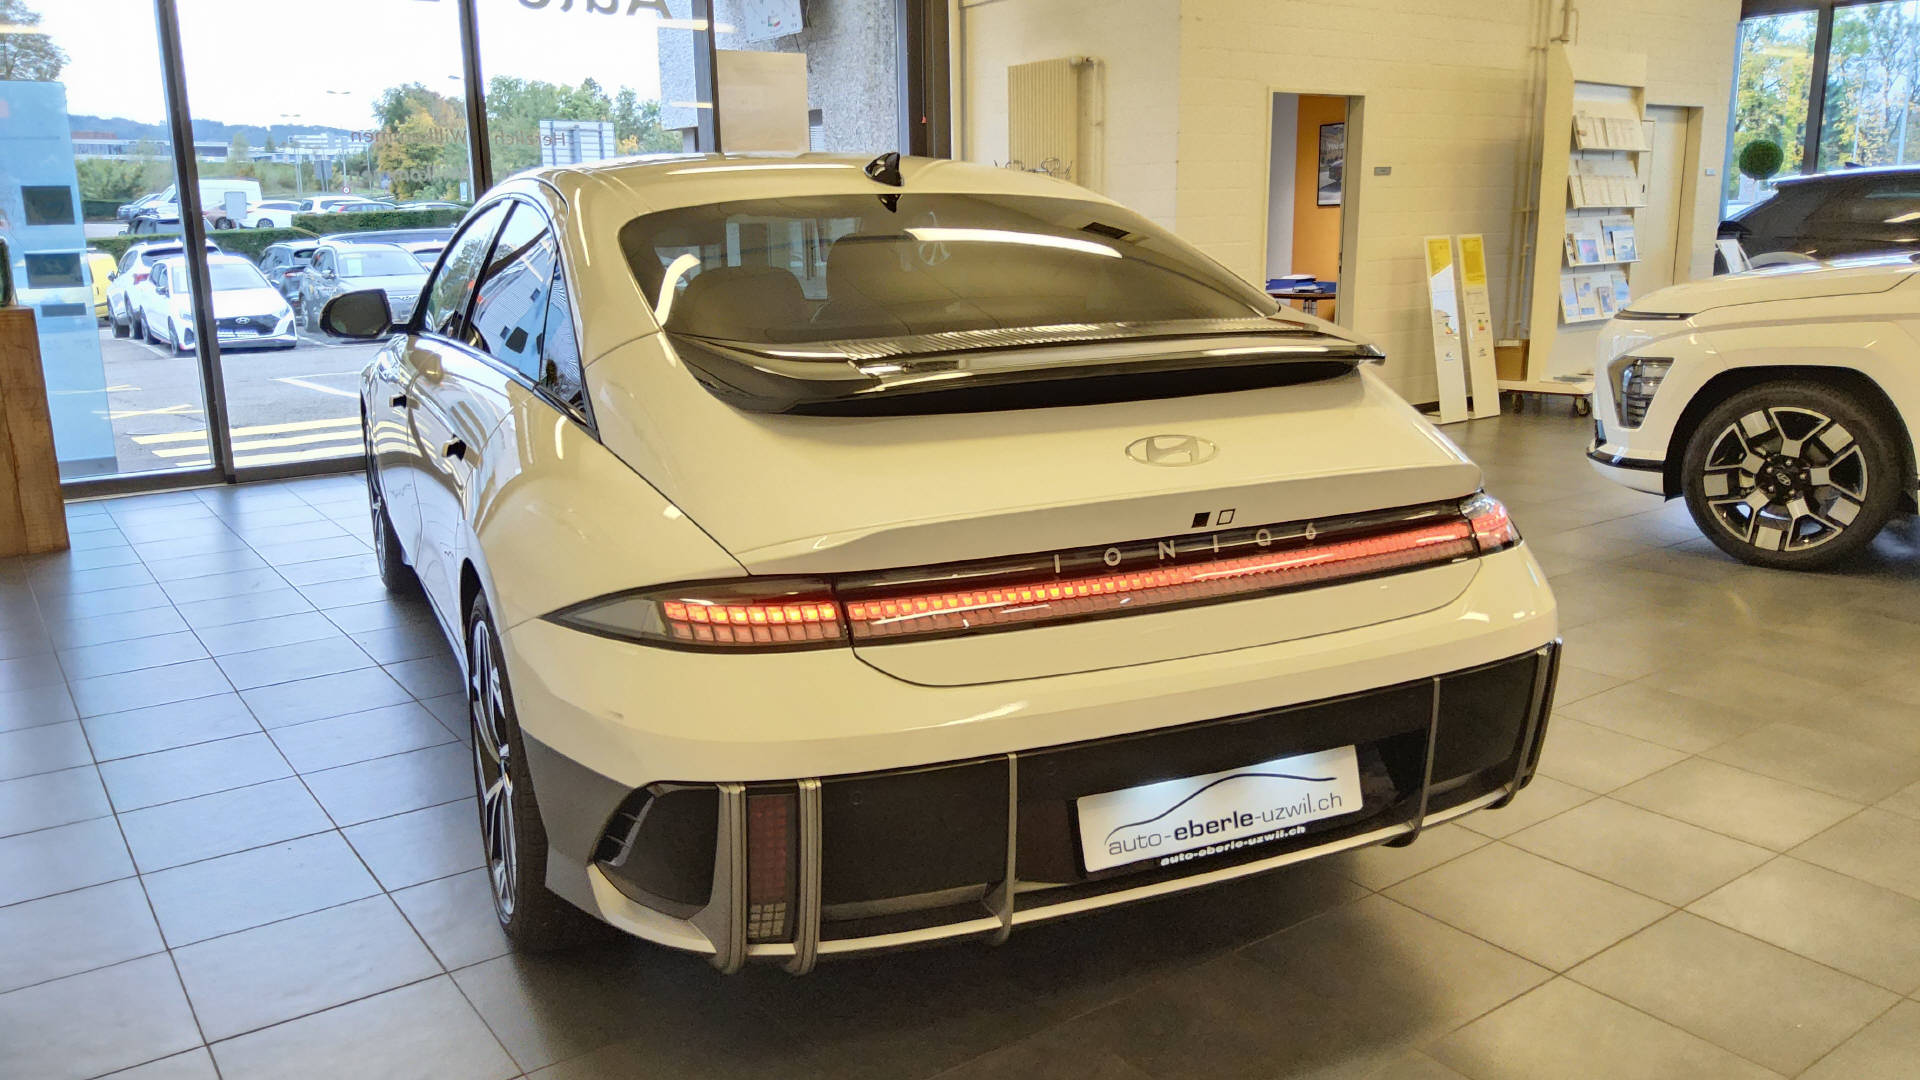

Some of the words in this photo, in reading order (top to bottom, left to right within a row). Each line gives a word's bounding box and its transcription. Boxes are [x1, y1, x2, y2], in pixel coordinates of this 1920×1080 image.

[1054, 528, 1272, 574] IONIQ
[1305, 522, 1317, 541] 6
[1108, 792, 1343, 856] auto-eberle-uzwil.ch
